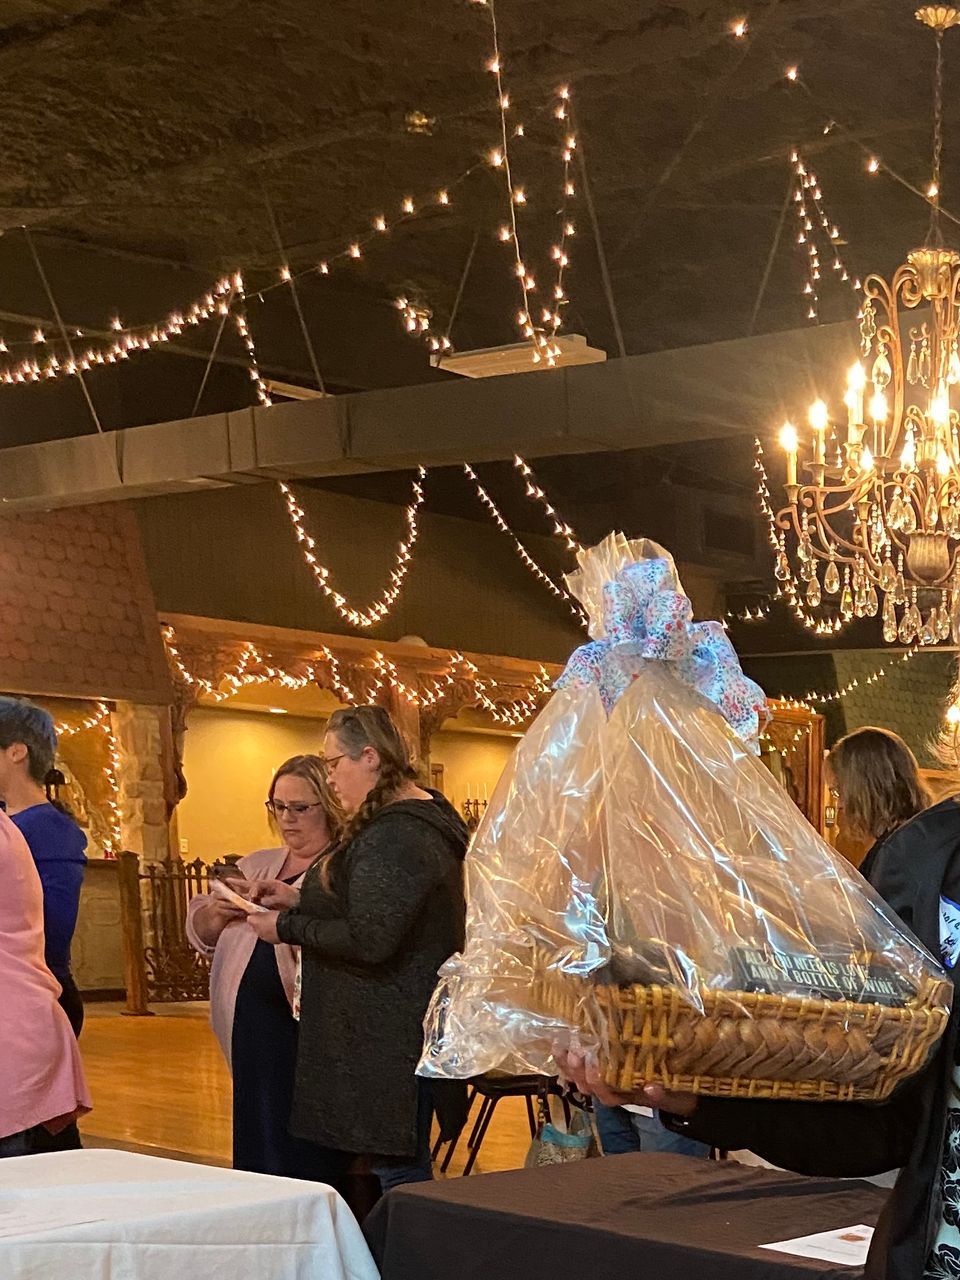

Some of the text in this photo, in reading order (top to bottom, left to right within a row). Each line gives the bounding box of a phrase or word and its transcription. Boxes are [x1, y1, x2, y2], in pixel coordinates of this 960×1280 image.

[794, 956, 826, 973] NEED
[826, 961, 840, 975] IS
[751, 965, 779, 981] AND
[793, 970, 843, 989] BOTTLE
[865, 979, 898, 996] WINE
